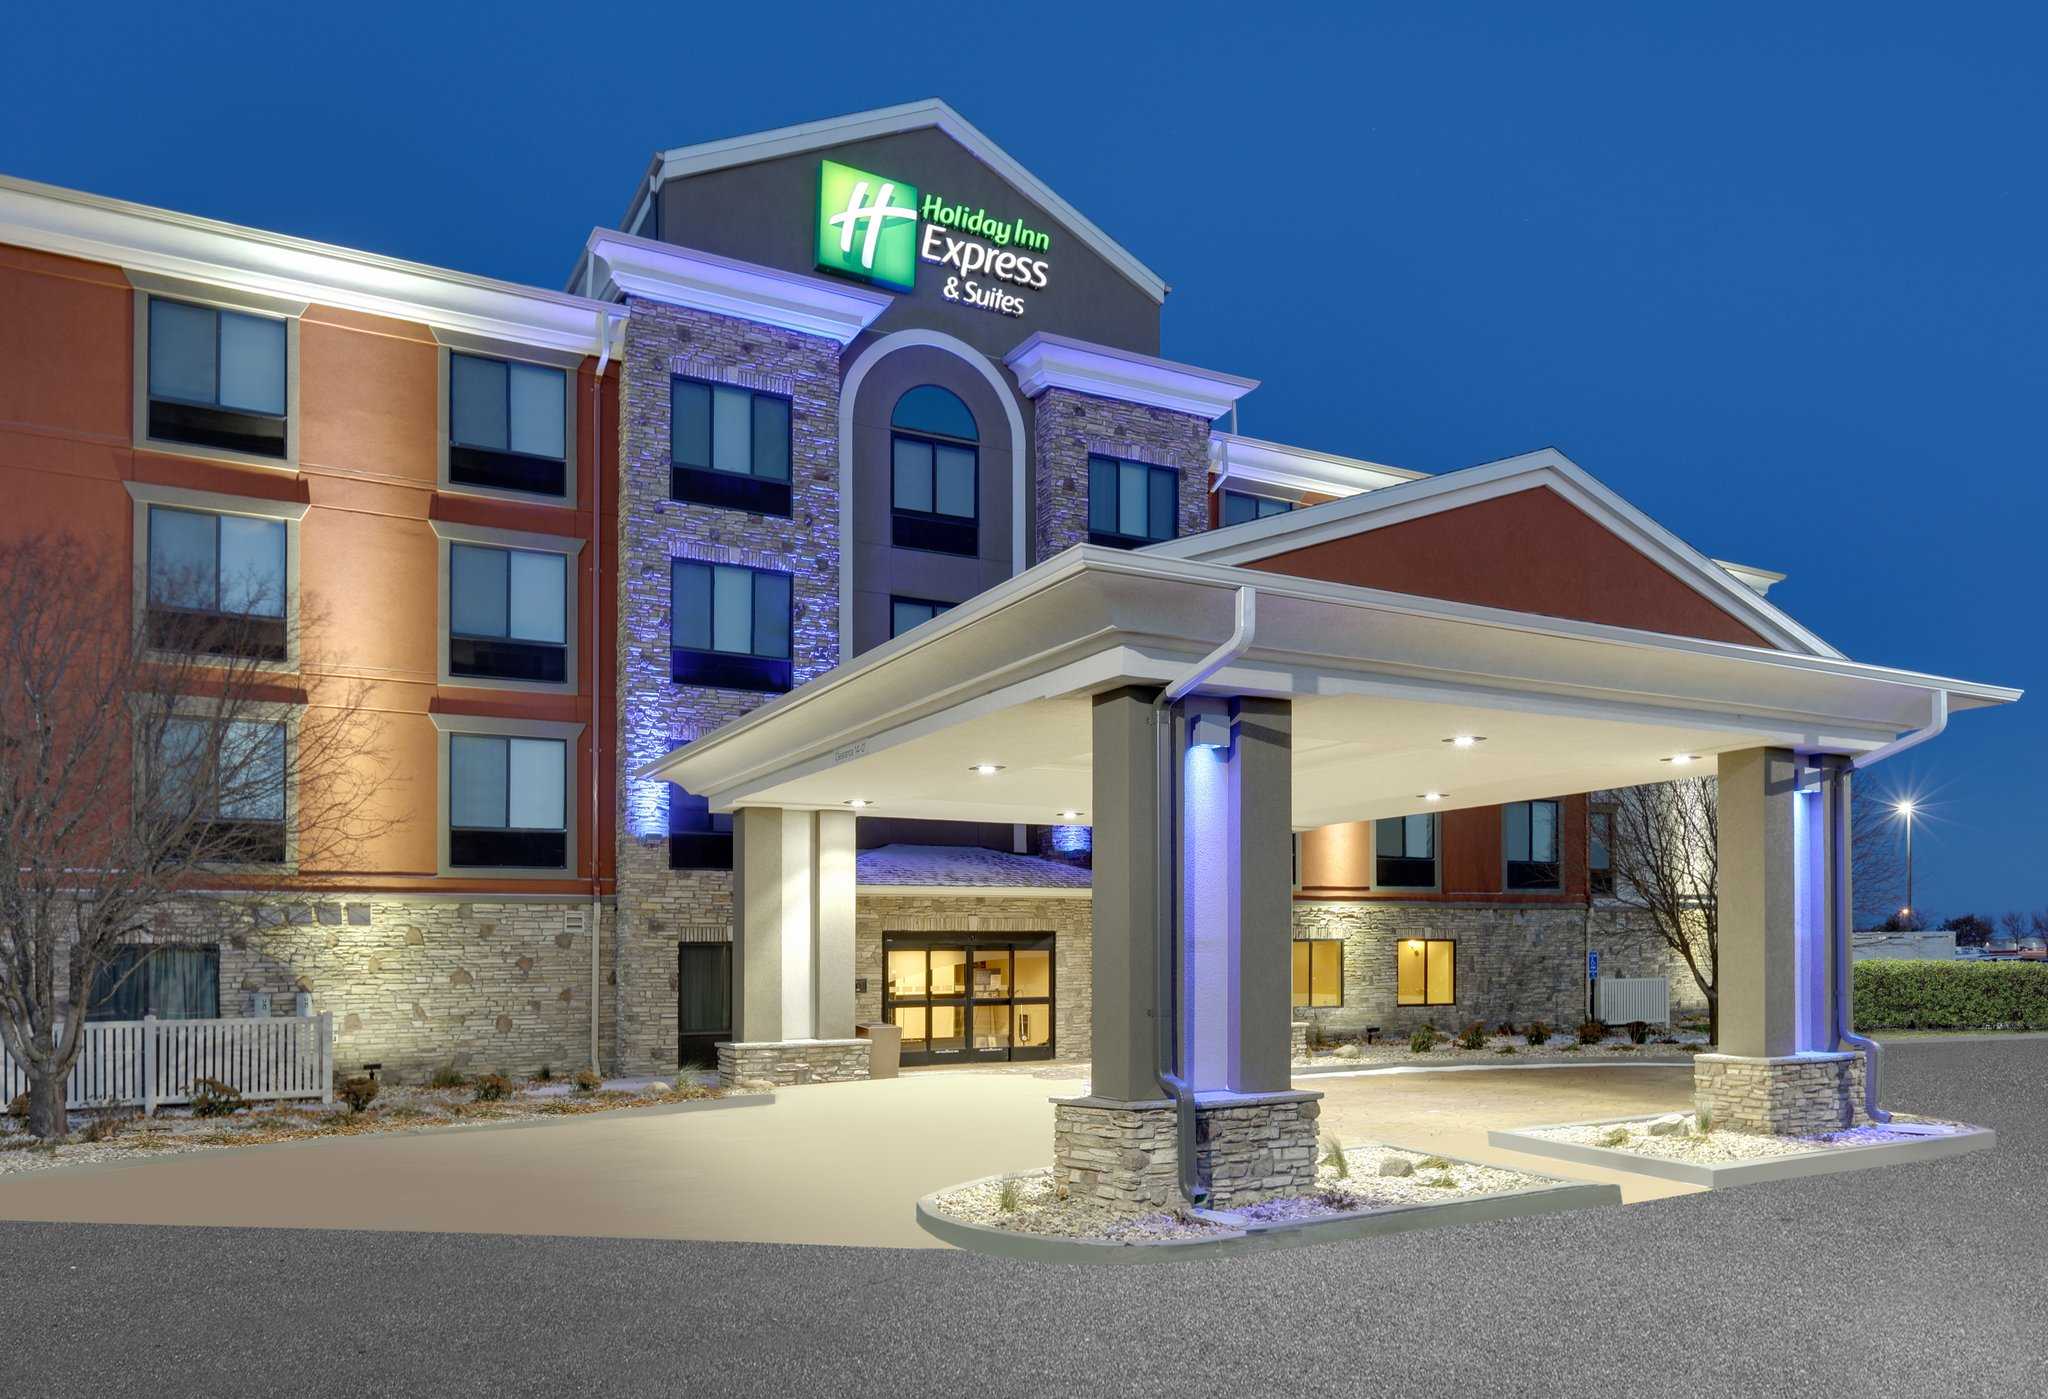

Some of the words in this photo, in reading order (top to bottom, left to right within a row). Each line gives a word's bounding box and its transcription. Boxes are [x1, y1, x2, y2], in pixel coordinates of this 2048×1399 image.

[921, 194, 1010, 244] Holiday
[1014, 219, 1050, 250] Inn
[921, 225, 1049, 288] Express
[943, 276, 960, 299] &
[963, 281, 1025, 316] Suites
